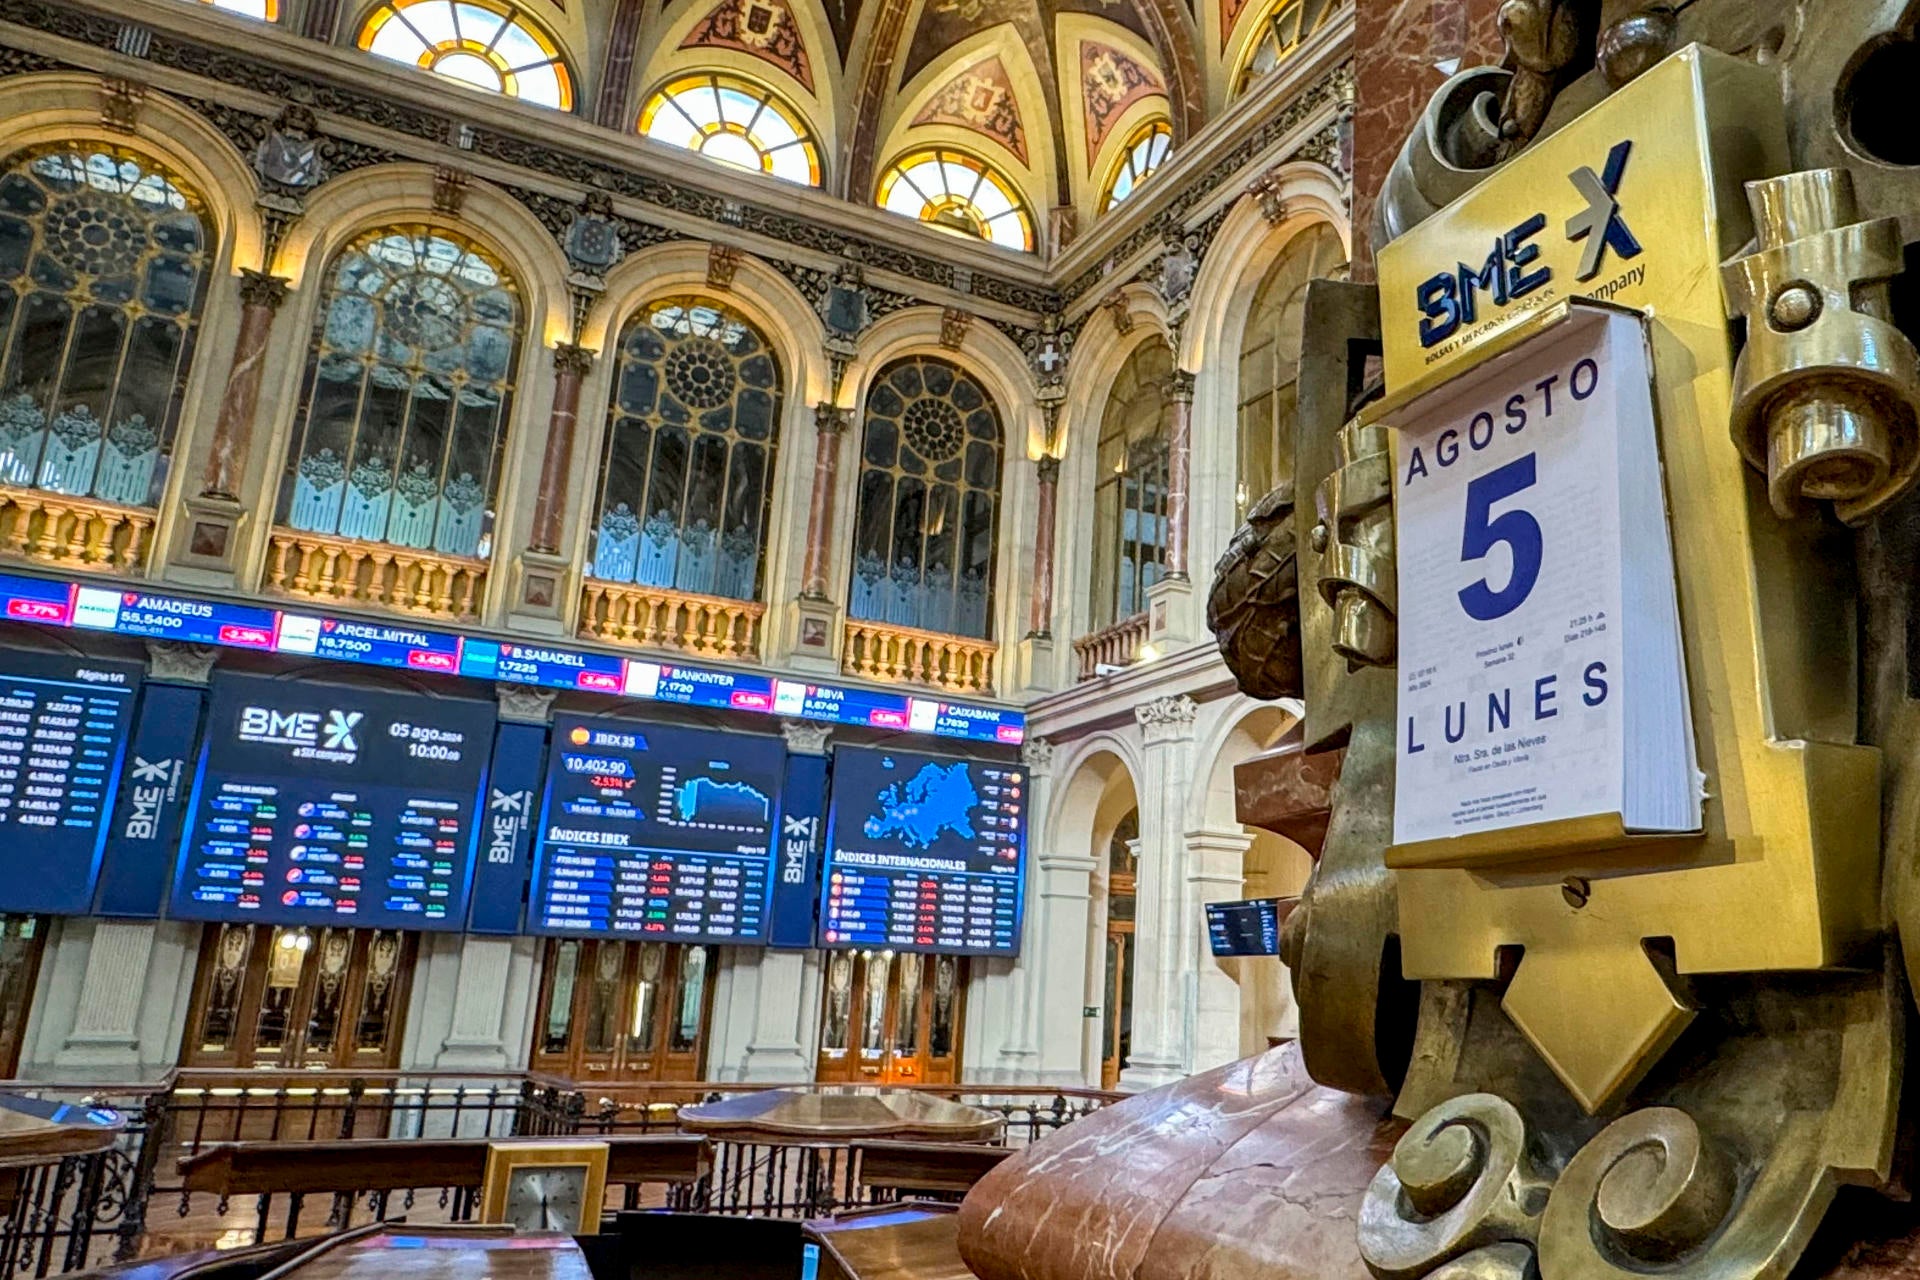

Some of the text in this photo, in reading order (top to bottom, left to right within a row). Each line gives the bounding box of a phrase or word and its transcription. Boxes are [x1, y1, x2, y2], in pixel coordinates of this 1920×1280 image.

[1417, 213, 1553, 348] BME
[1586, 264, 1646, 300] ompany
[1405, 358, 1599, 485] AGOSTO
[1457, 452, 1544, 621] 5
[137, 597, 213, 617] AMADEUS
[512, 647, 585, 667] B.SABADELL
[672, 668, 734, 687] BANKINTER
[816, 687, 844, 701] BBVA
[1407, 661, 1609, 753] LUNES
[240, 707, 321, 739] BME
[390, 722, 410, 737] 05
[594, 732, 636, 748] IBEX 35
[566, 757, 626, 774] 10.402,90
[125, 785, 160, 839] BME
[488, 815, 514, 863] BME
[549, 826, 630, 846] ÍNDICES IBEX
[783, 839, 804, 883] BME
[834, 849, 966, 872] ÍNDICES INTERNACIONALES
